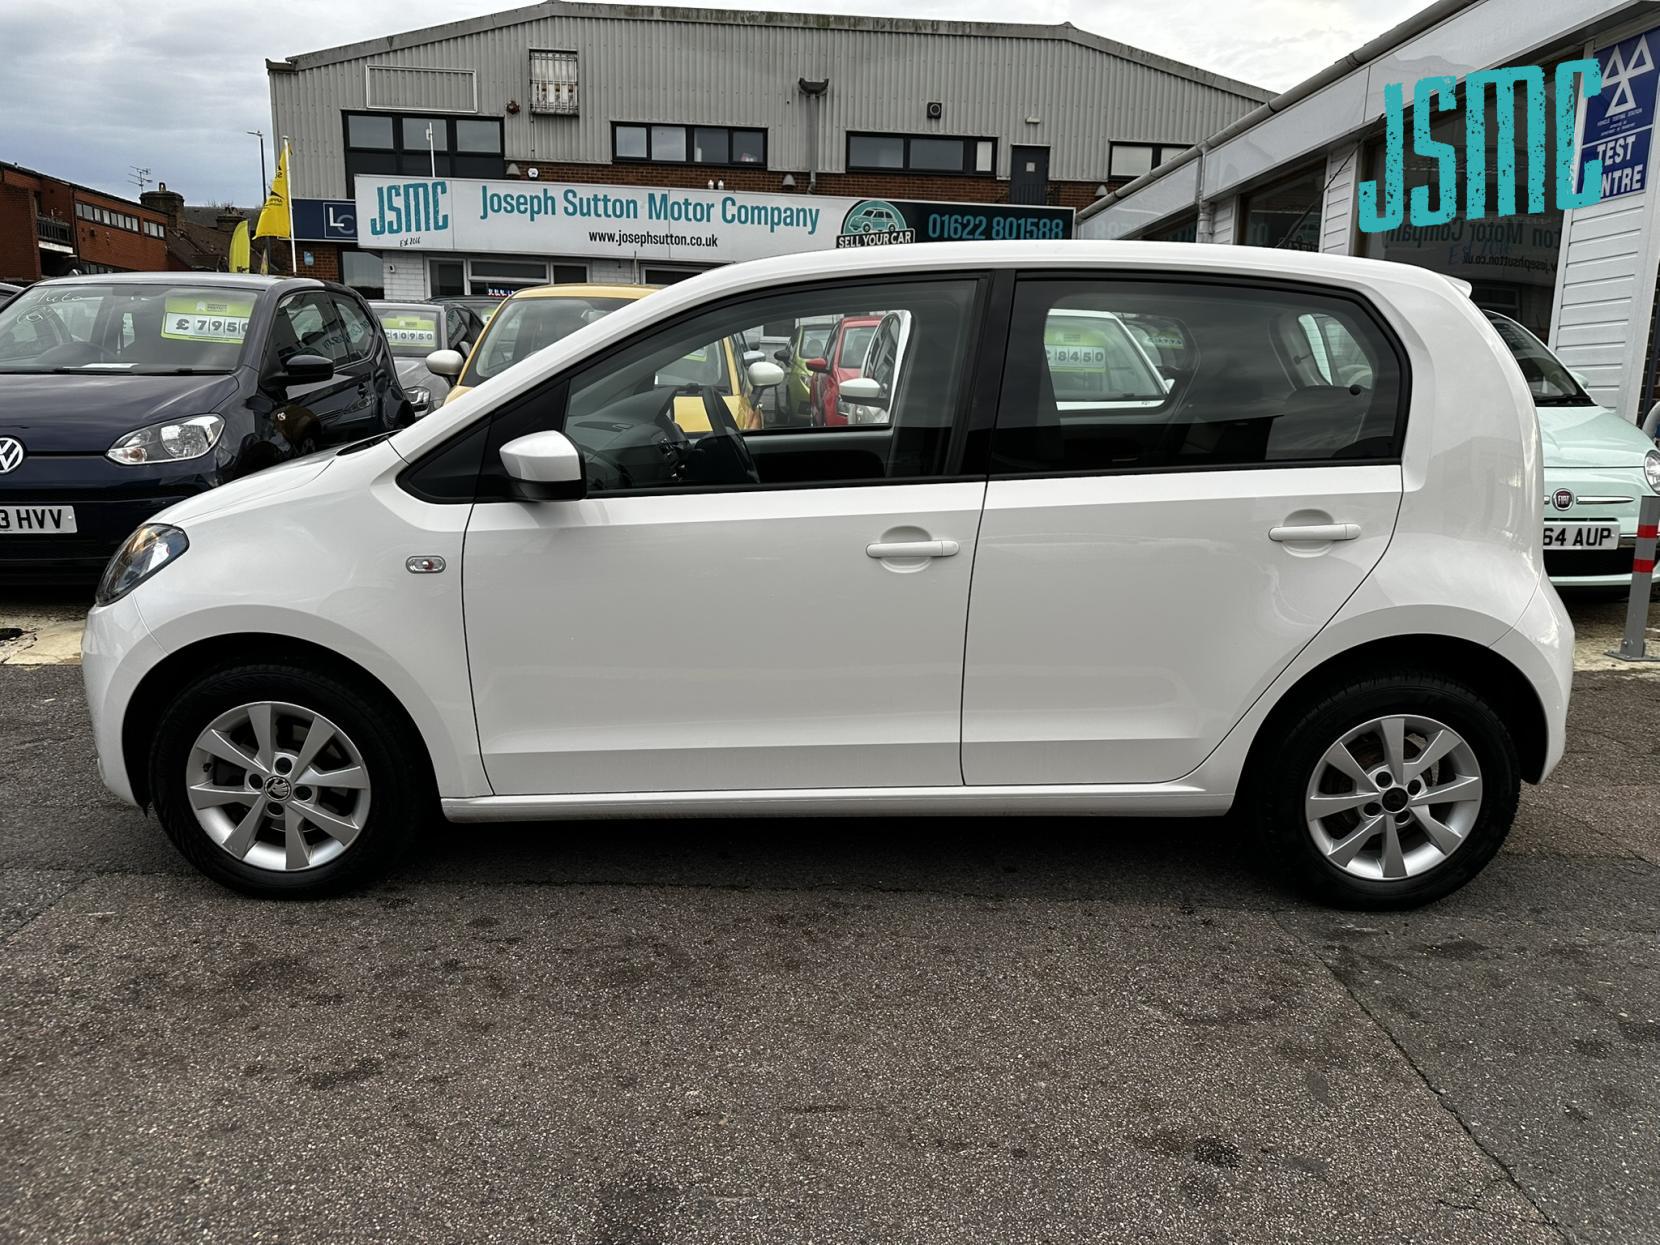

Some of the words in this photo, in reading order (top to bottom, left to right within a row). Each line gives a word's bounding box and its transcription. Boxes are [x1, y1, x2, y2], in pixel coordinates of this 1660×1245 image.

[1597, 134, 1636, 166] TEST
[1600, 164, 1643, 198] NTRE
[370, 181, 449, 236] JSMC
[480, 185, 556, 222] Joseph
[563, 188, 638, 219] Sutton
[647, 192, 715, 223] Motor
[721, 196, 820, 235] Company
[588, 229, 718, 248] www.josephsutton.co.uk
[928, 213, 986, 240] 01622
[991, 216, 1064, 240] 801588
[838, 235, 861, 249] SELL
[863, 233, 889, 246] YOUR
[890, 231, 911, 244] CAR
[1557, 495, 1570, 505] FIAT
[15, 508, 62, 529] HVV
[1572, 527, 1611, 546] AUP
